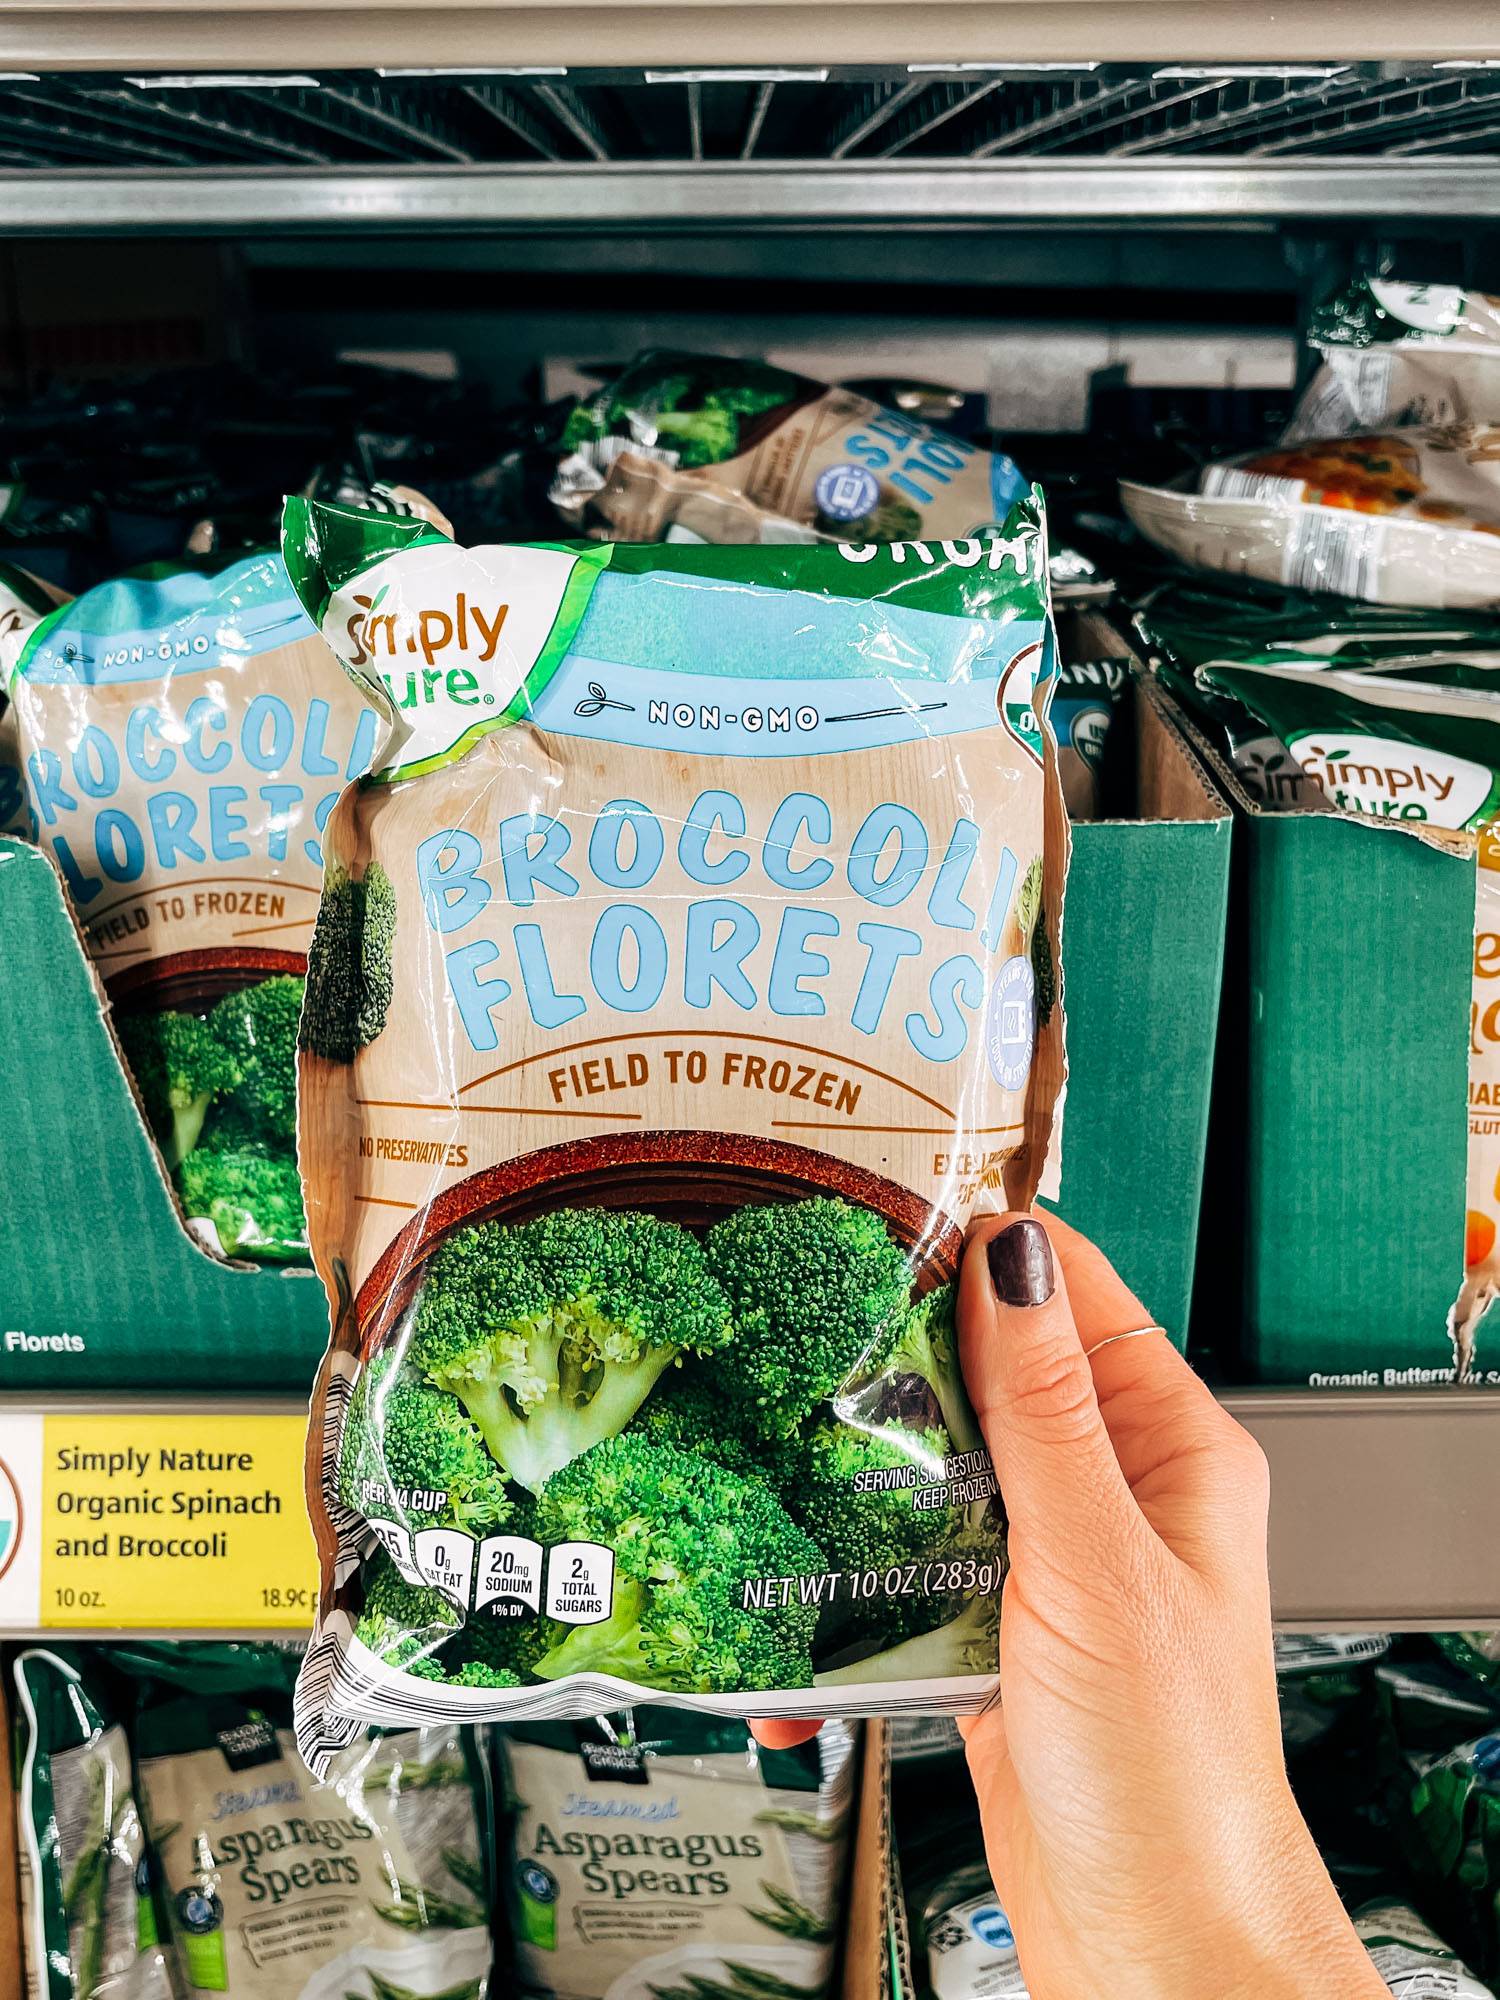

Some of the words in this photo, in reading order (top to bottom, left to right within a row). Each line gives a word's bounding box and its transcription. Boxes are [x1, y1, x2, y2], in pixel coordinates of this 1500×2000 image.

[648, 700, 820, 732] NON-GMO
[416, 790, 1018, 954] BROCCOLI
[155, 898, 185, 922] TO
[194, 892, 285, 919] FROZEN
[444, 898, 985, 1062] FLORETS
[548, 1053, 649, 1104] FIELD
[664, 1050, 707, 1084] TO
[722, 1052, 862, 1116] FROZEN
[359, 1136, 374, 1158] NO
[376, 1138, 468, 1168] PRESERVATIVES
[5, 1331, 86, 1352] Florets
[1309, 1370, 1379, 1387] Organic
[57, 1446, 150, 1477] Simply
[159, 1448, 253, 1472] Nature
[853, 1464, 917, 1493] SERVING
[912, 1486, 949, 1511] KEEP
[951, 1474, 999, 1506] FROZEN
[57, 1489, 163, 1520] Organic
[171, 1489, 281, 1520] Spinach
[411, 1489, 447, 1512] CUP
[56, 1534, 108, 1557] and
[118, 1532, 227, 1557] Broccoli
[490, 1551, 529, 1577] 20mg
[443, 1573, 464, 1588] FAT
[485, 1576, 533, 1594] SODIUM
[562, 1582, 597, 1596] TOTAL
[743, 1577, 794, 1609] NET
[799, 1572, 842, 1605] WT
[849, 1570, 878, 1599] 10
[884, 1564, 918, 1597] OZ
[923, 1555, 1002, 1596] (283g)
[56, 1588, 75, 1607] 10
[80, 1592, 106, 1607] oz.
[491, 1603, 508, 1615] 1%
[509, 1604, 524, 1617] DV
[555, 1599, 602, 1613] SUGARS
[533, 1822, 764, 1867] Asparagus
[239, 1853, 361, 1903] Spears
[581, 1862, 730, 1900] Spears
